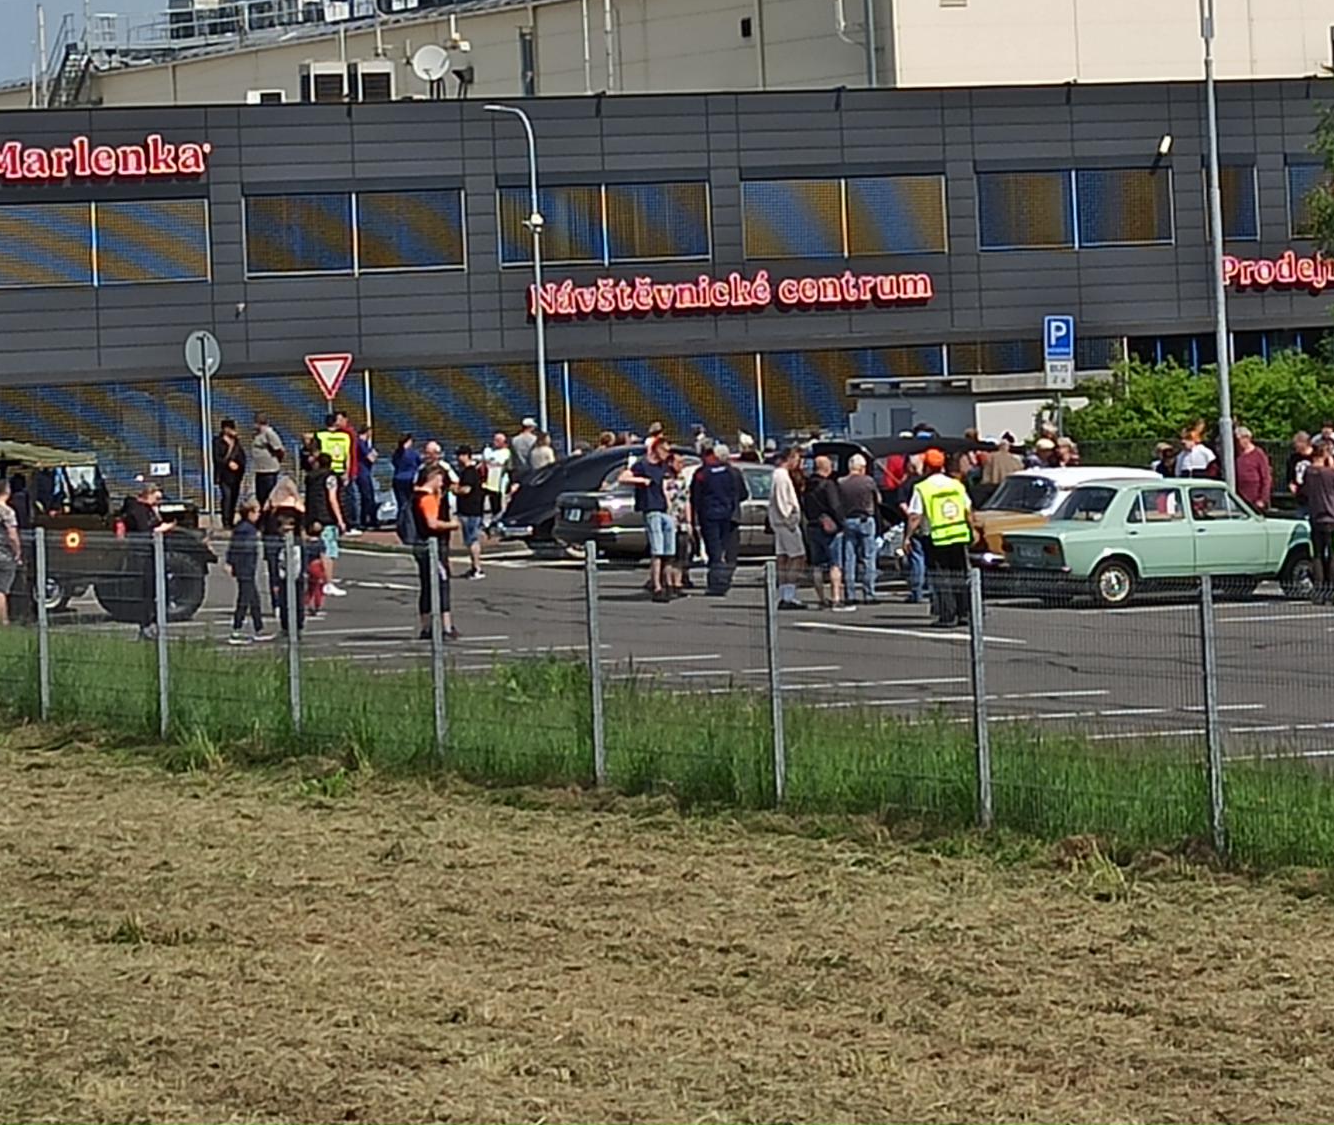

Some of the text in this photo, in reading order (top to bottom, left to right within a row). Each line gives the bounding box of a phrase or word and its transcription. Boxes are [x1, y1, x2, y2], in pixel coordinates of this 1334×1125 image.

[530, 271, 933, 314] Návštěvnické centrum
[1050, 321, 1067, 345] P
